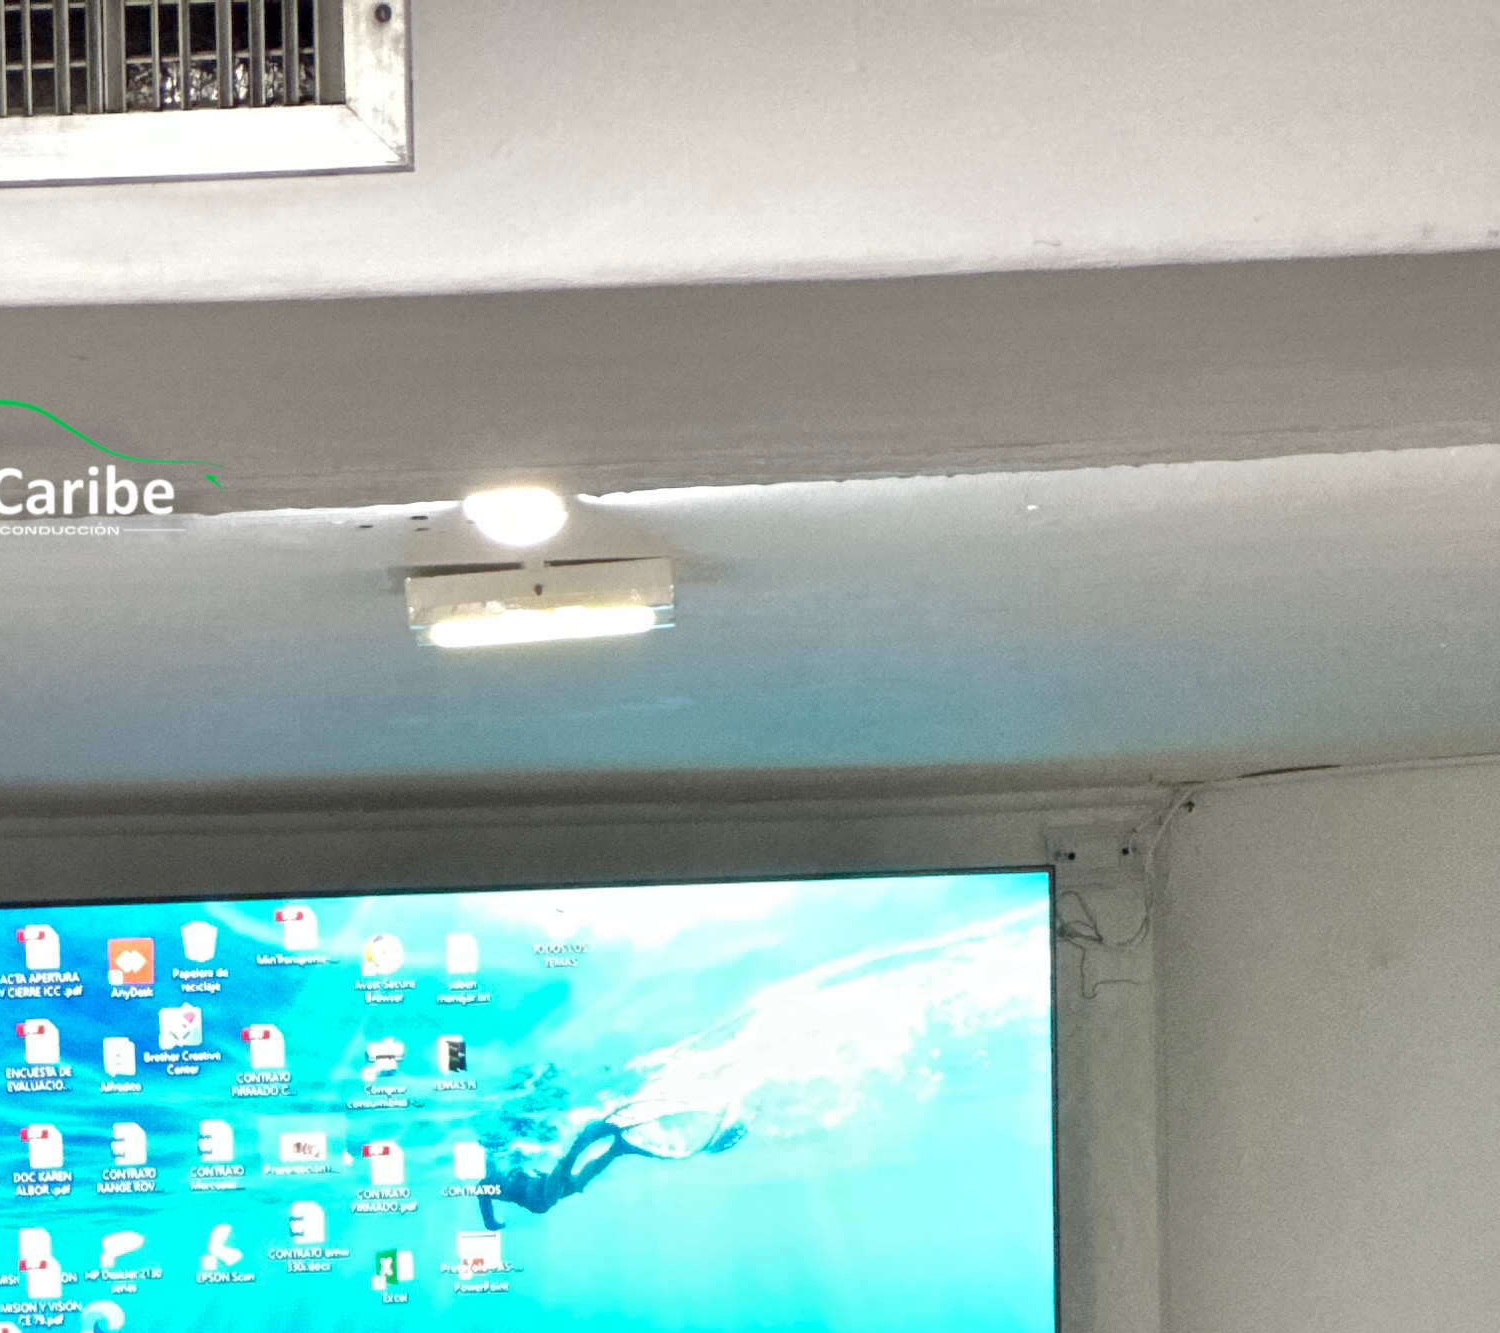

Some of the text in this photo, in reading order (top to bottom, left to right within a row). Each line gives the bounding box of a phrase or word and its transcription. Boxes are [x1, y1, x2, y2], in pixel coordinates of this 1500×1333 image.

[0, 972, 80, 985] ACTA APERTURA
[8, 986, 41, 998] CIERRE
[111, 987, 154, 1000] AnyDesk
[5, 1065, 72, 1079] ENCUESTA DE
[13, 1172, 36, 1184] DOC
[441, 1184, 501, 1197] CONTRATOS
[196, 1272, 230, 1284] EPSON
